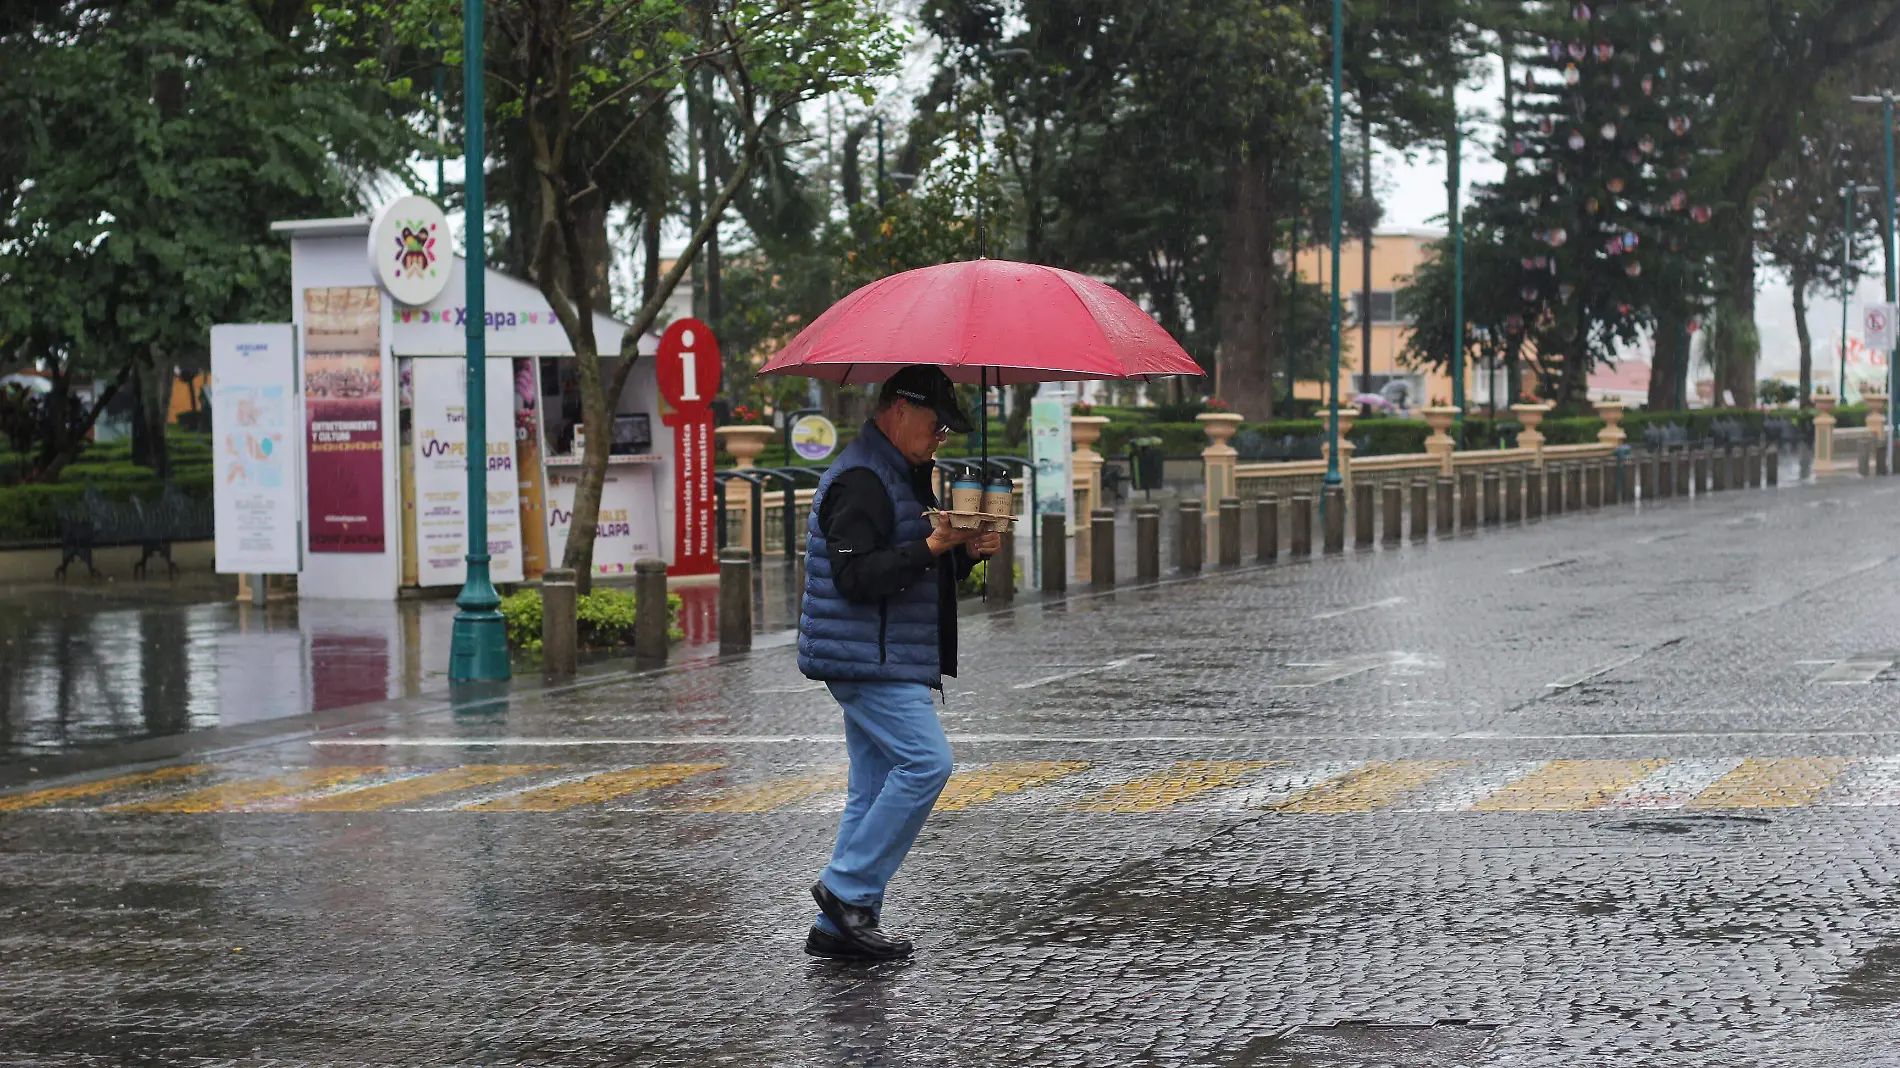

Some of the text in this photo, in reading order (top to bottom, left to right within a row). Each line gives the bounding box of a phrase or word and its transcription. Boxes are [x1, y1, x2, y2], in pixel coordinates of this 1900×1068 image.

[455, 307, 516, 331] Xapa
[684, 480, 692, 556] Información
[698, 423, 708, 554] Tourist Information
